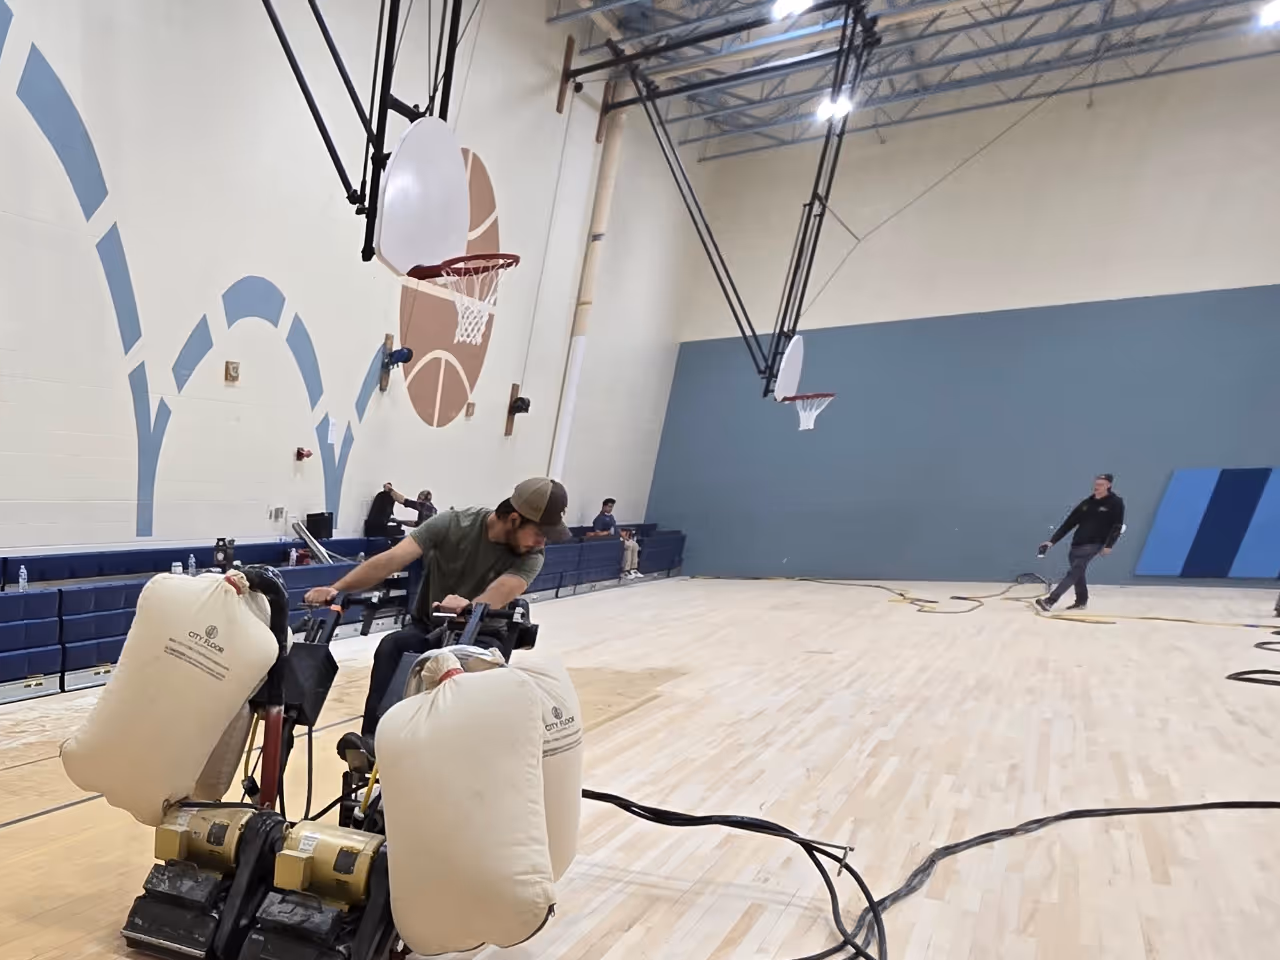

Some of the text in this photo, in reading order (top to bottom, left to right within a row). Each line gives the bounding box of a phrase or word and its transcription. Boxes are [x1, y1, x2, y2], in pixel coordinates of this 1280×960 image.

[188, 631, 204, 641] CITY
[203, 638, 224, 653] FLOOR
[545, 722, 558, 731] CITY
